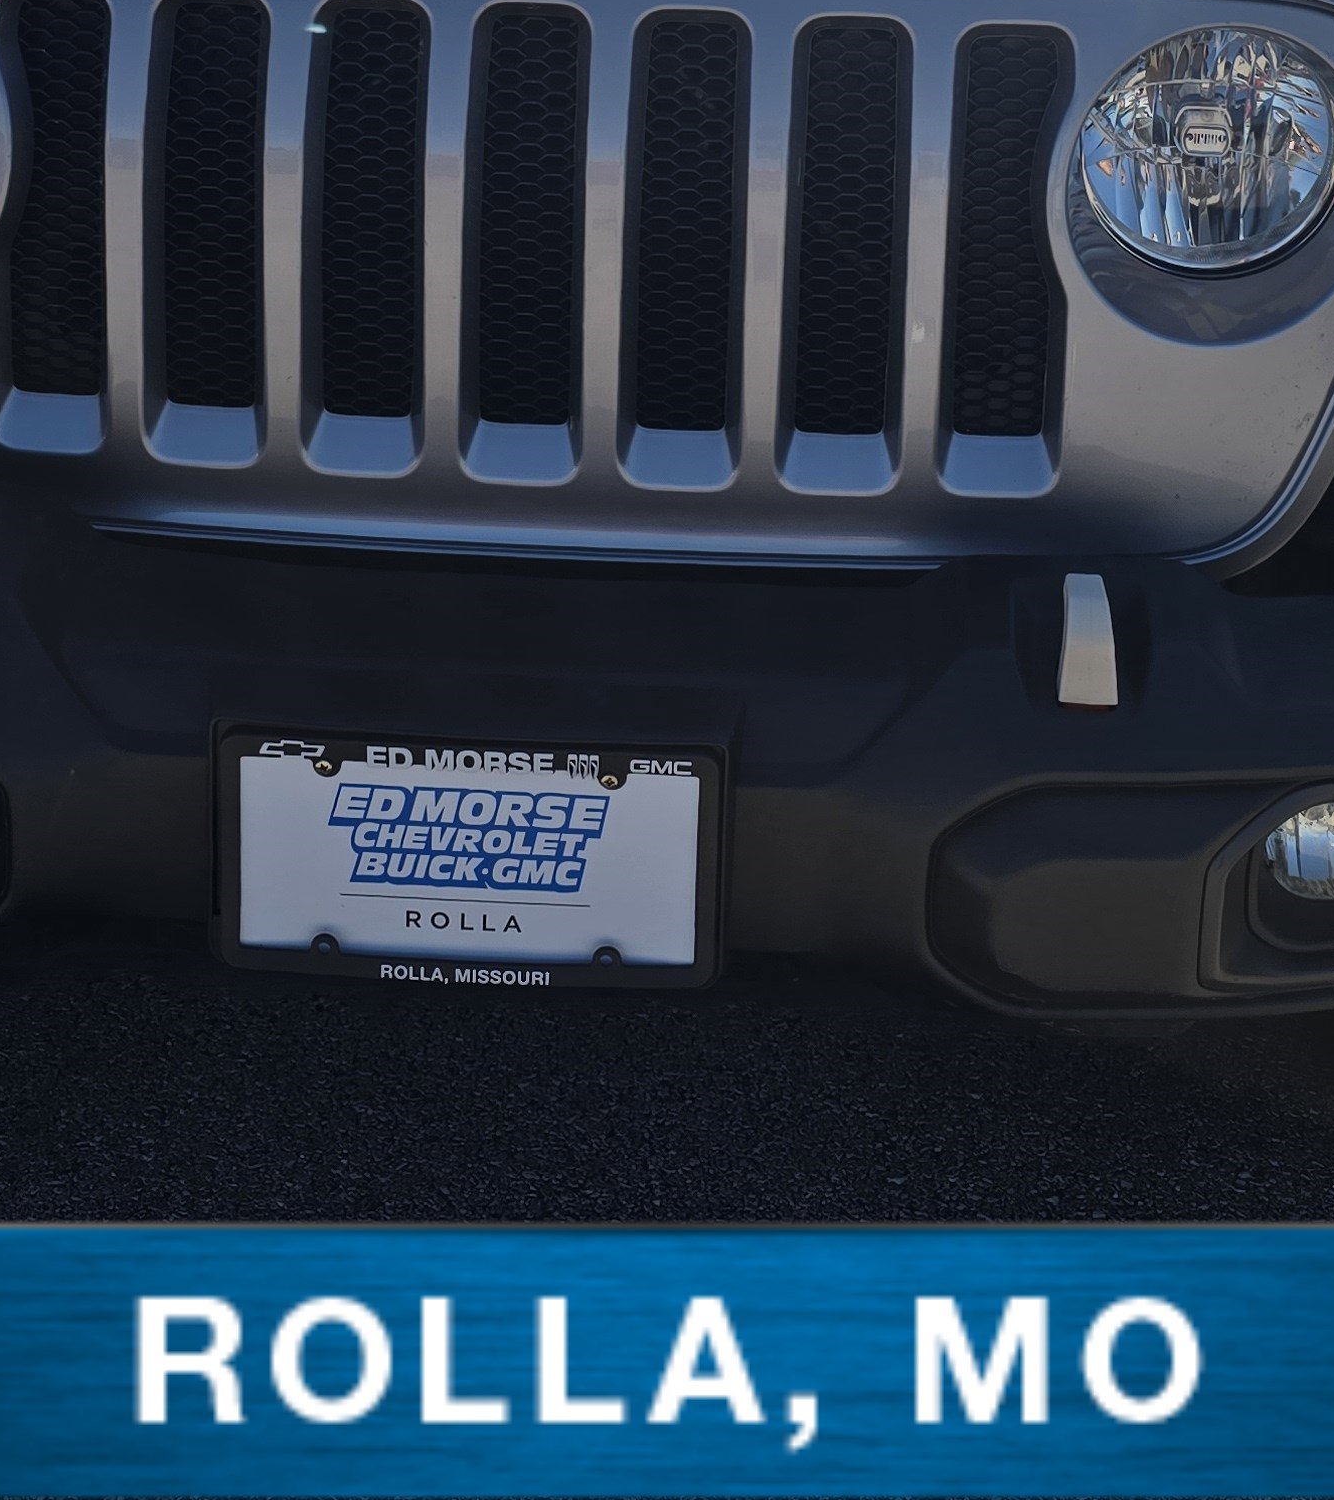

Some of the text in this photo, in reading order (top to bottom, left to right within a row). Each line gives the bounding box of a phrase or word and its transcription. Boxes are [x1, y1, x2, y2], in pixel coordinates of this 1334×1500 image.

[366, 745, 555, 775] ED MORSE
[629, 759, 693, 777] GMC
[332, 786, 607, 831] ED MORSE
[353, 823, 584, 858] CHEVROLET
[405, 910, 523, 933] ROLLA
[380, 964, 551, 987] ROLLA, MISSOURI
